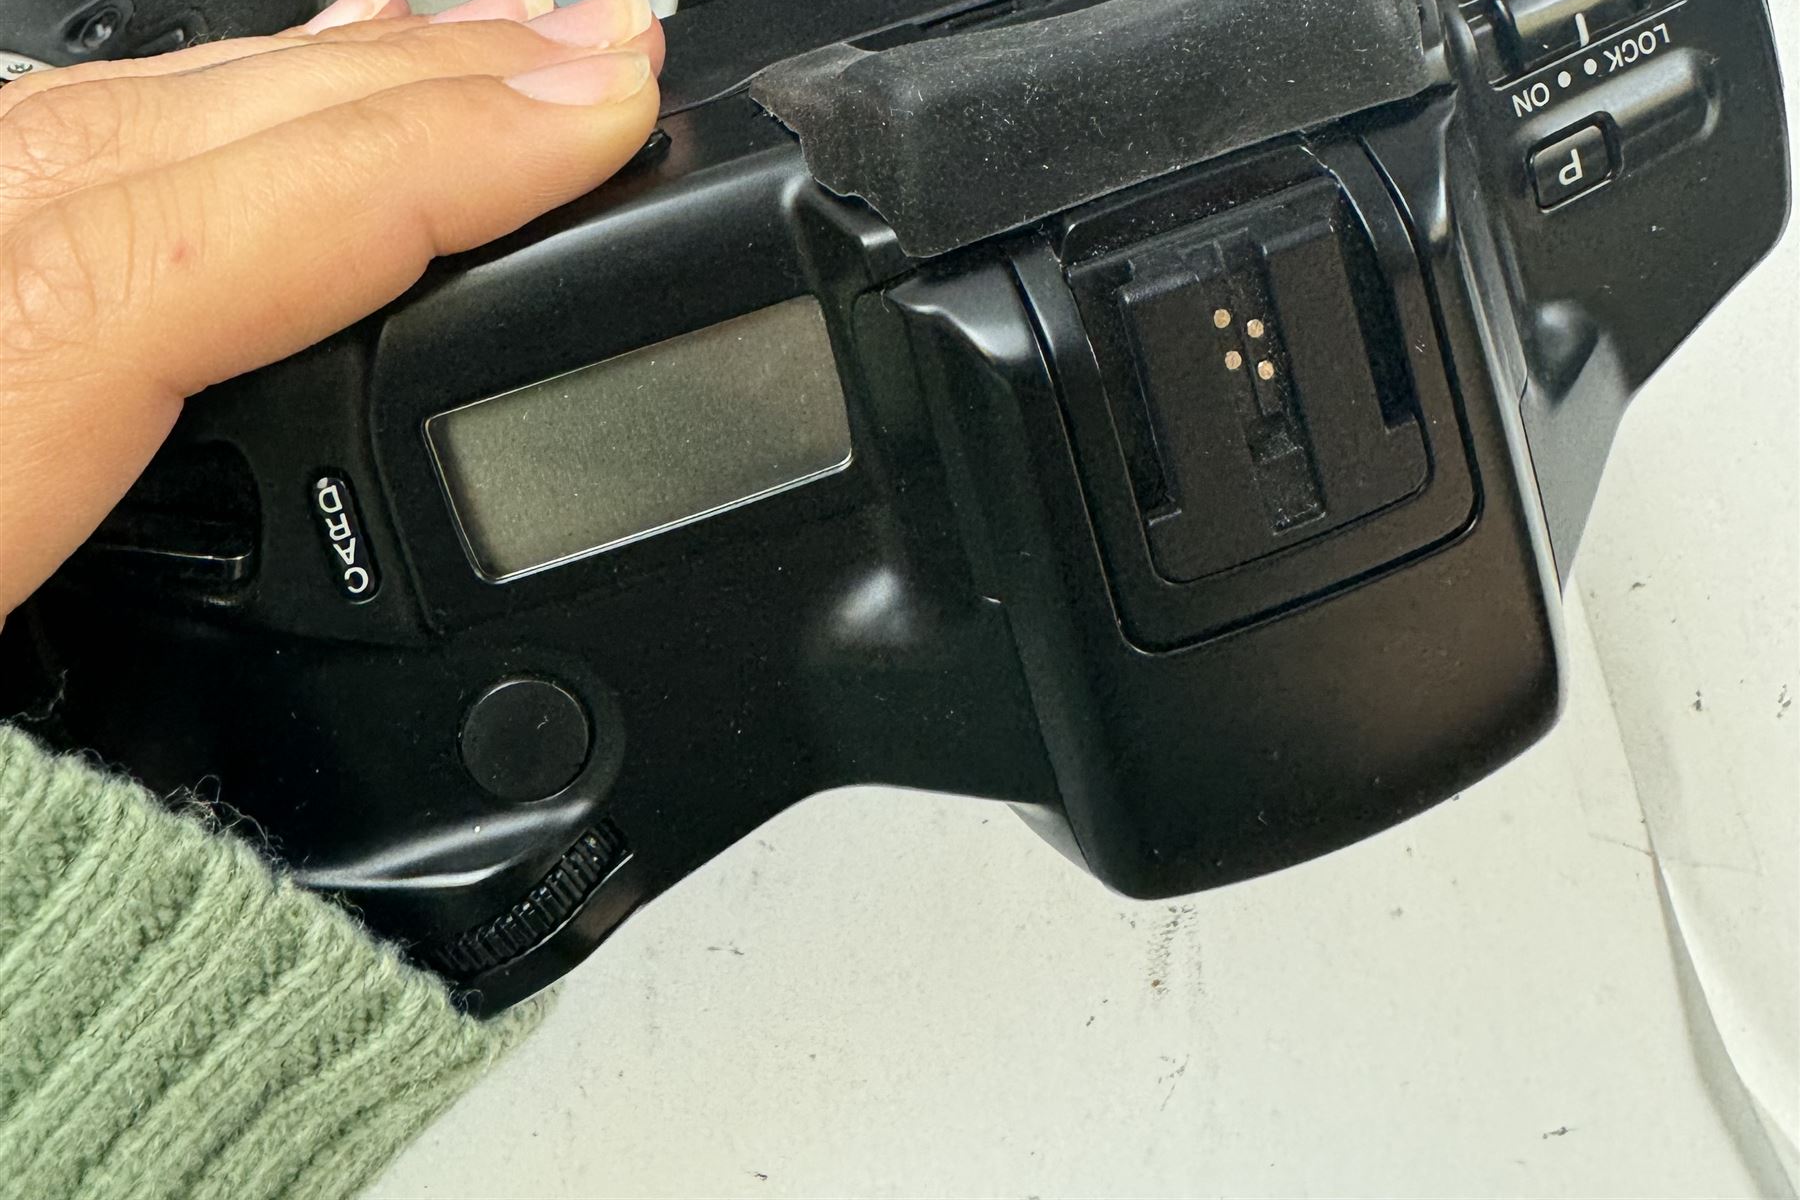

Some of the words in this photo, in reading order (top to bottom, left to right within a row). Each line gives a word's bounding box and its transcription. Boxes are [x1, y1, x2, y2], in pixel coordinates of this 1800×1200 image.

[1603, 23, 1671, 72] LOCK
[1511, 82, 1550, 117] ON
[1559, 149, 1583, 186] P
[318, 485, 369, 593] CARD
